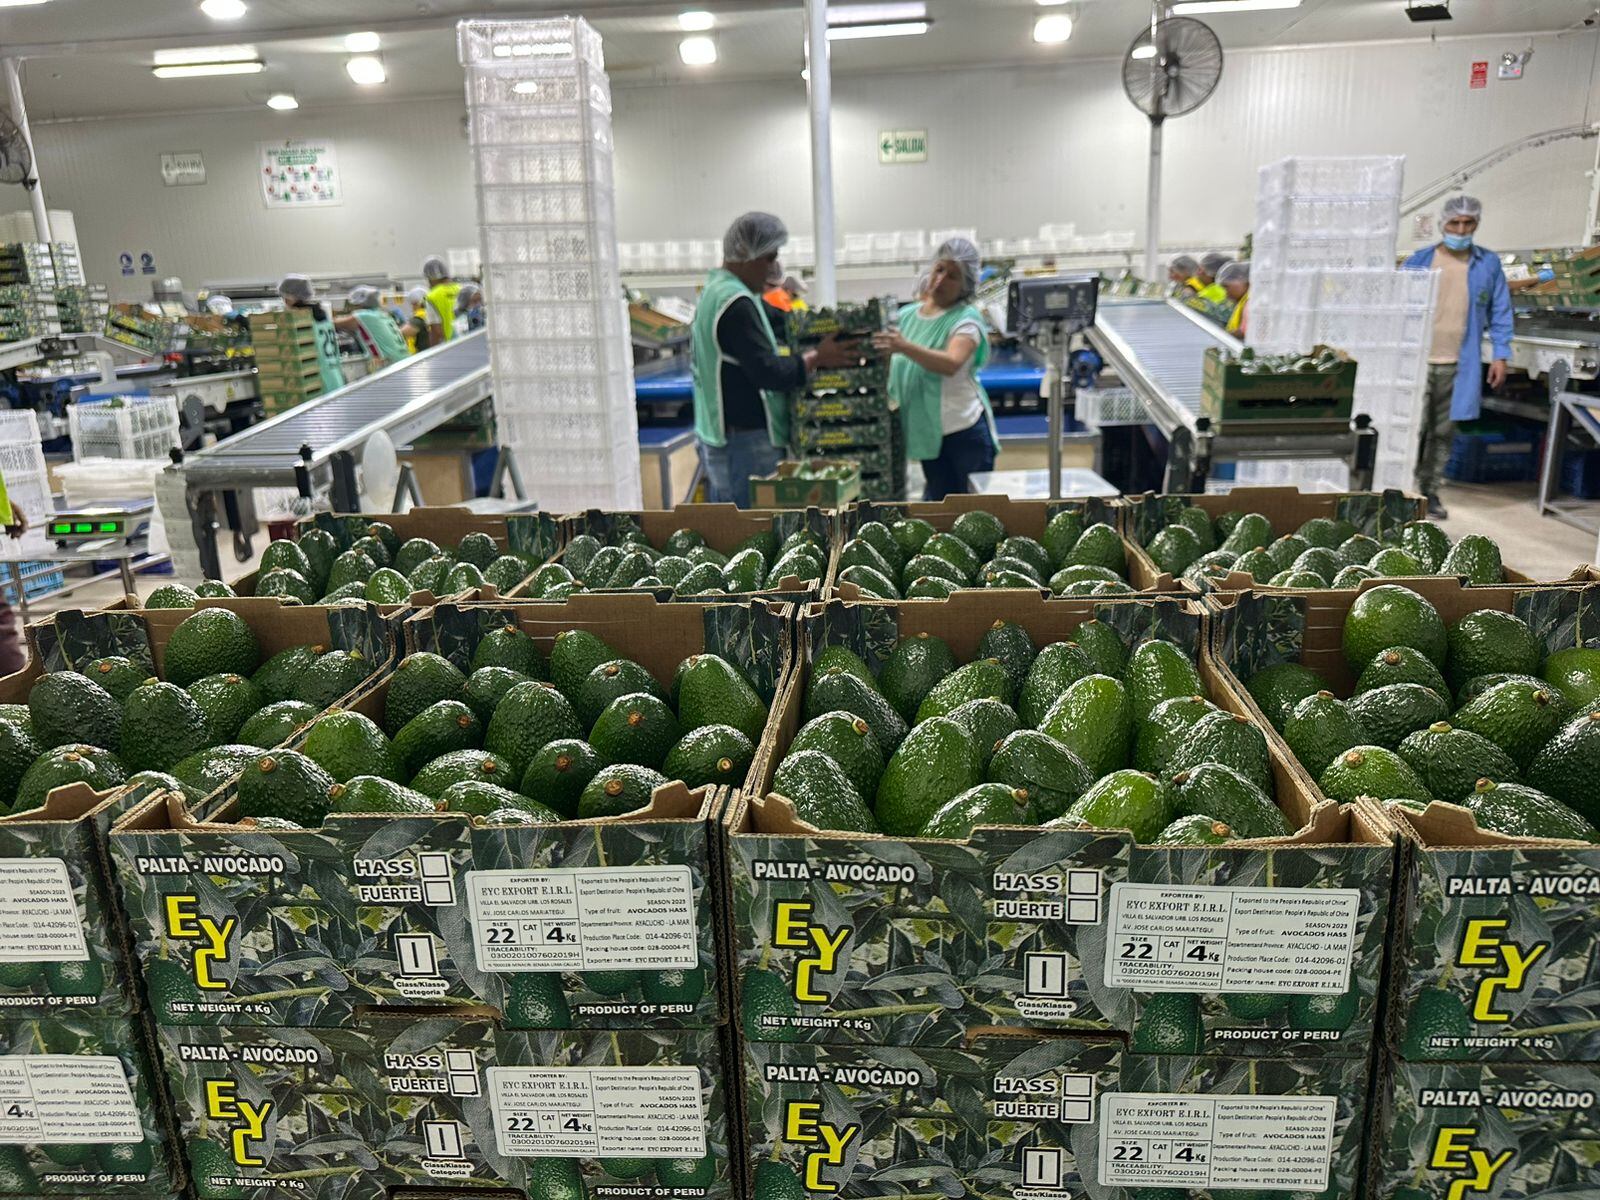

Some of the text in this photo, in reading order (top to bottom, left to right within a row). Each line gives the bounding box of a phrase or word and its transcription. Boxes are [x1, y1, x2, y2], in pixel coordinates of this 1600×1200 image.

[138, 857, 189, 873] PALTA
[204, 857, 284, 873] AVOCADO
[356, 860, 414, 875] HASS
[755, 863, 811, 879] PALTA
[826, 865, 915, 883] AVOCADO
[995, 875, 1060, 890] HASS
[1450, 878, 1511, 894] PALTA
[361, 887, 419, 900] FUERTE
[996, 903, 1061, 916] FUERTE
[1126, 901, 1227, 913] EYC EXPORT E.I.R.L.
[486, 928, 516, 943] 22
[546, 927, 576, 943] 4 Kg
[1121, 943, 1153, 959] 22
[1186, 945, 1220, 962] 4 Kg
[1121, 968, 1219, 977] 0300201007602019H
[396, 981, 446, 989] Class/Klasse
[48, 997, 62, 1005] OF
[66, 996, 97, 1005] PERU
[173, 1004, 271, 1014] NET WEIGHT 4 Kg
[579, 1005, 693, 1015] PRODUCT OF PERU
[1023, 1009, 1066, 1017] Categoria
[763, 1016, 871, 1030] NET WEIGHT 4 Kg
[1215, 1031, 1340, 1040] PRODUCT OF PERU
[1432, 1038, 1553, 1048] NET WEIGHT 4 Kg
[181, 1046, 228, 1061] PALTA
[242, 1047, 318, 1063] AVOCADO
[386, 1056, 440, 1068] HASS
[767, 1065, 819, 1081] PALTA
[835, 1068, 920, 1085] AVOCADO
[391, 1078, 447, 1091] FUERTE
[995, 1078, 1056, 1093] HASS
[1422, 1090, 1480, 1106] PALTA
[1497, 1092, 1594, 1108] AVOCADO
[8, 1105, 25, 1118] 4
[996, 1103, 1056, 1117] FUERTE
[507, 1118, 535, 1131] 22
[563, 1118, 581, 1131] 4
[1113, 1146, 1143, 1161] 22
[1175, 1147, 1206, 1162] 4 Kg
[45, 1174, 96, 1182] PRODUCT
[117, 1174, 146, 1182] PERU
[212, 1177, 232, 1185] NET
[235, 1178, 278, 1187] WEIGHT
[289, 1180, 304, 1189] Kg
[674, 1188, 705, 1196] PERU
